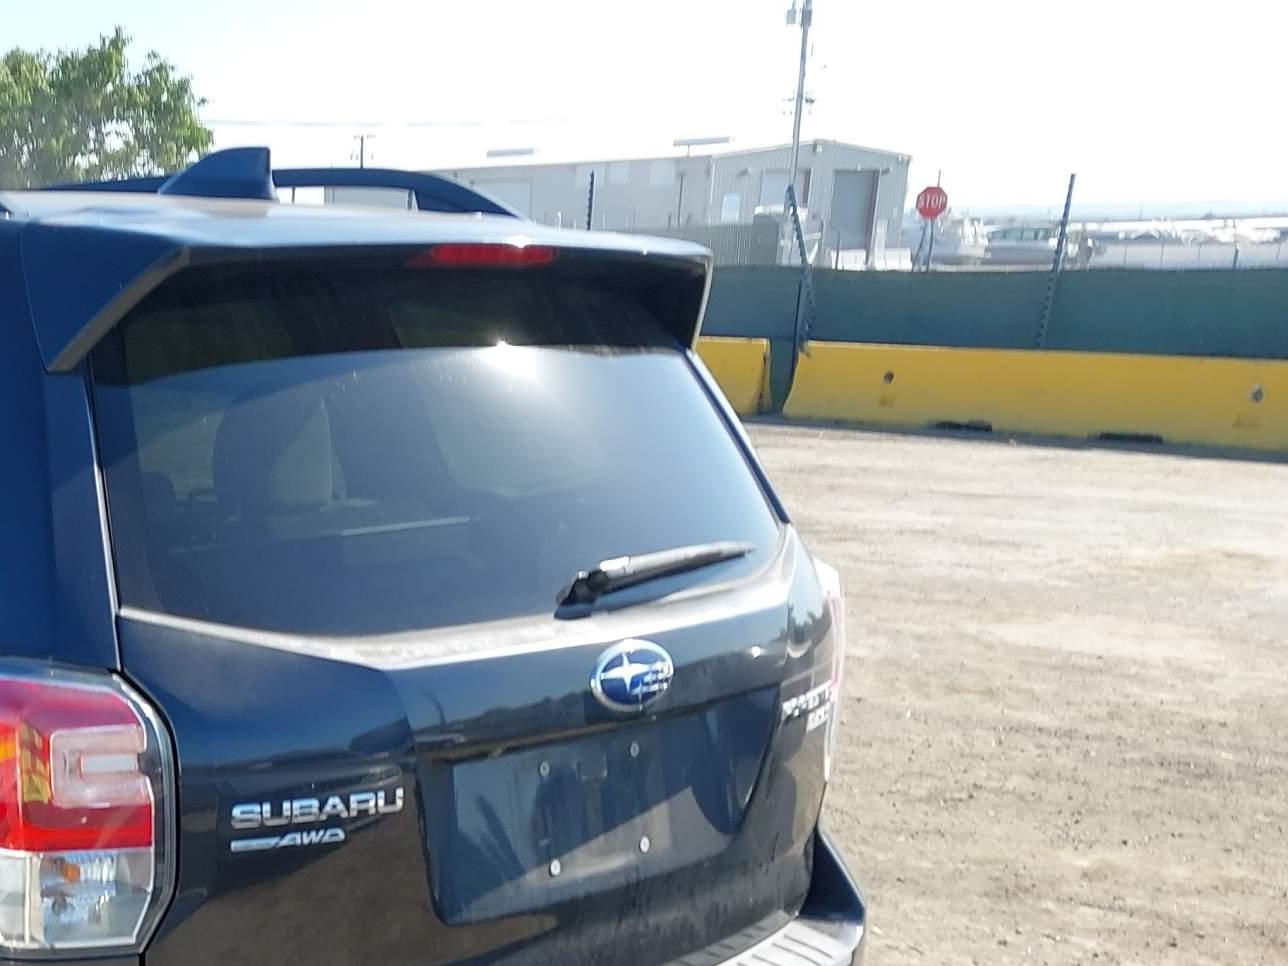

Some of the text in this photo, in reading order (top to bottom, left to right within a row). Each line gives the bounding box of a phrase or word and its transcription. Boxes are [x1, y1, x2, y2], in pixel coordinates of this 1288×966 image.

[918, 192, 946, 209] STOP
[231, 787, 404, 829] SUBARU
[277, 827, 345, 848] AWD
